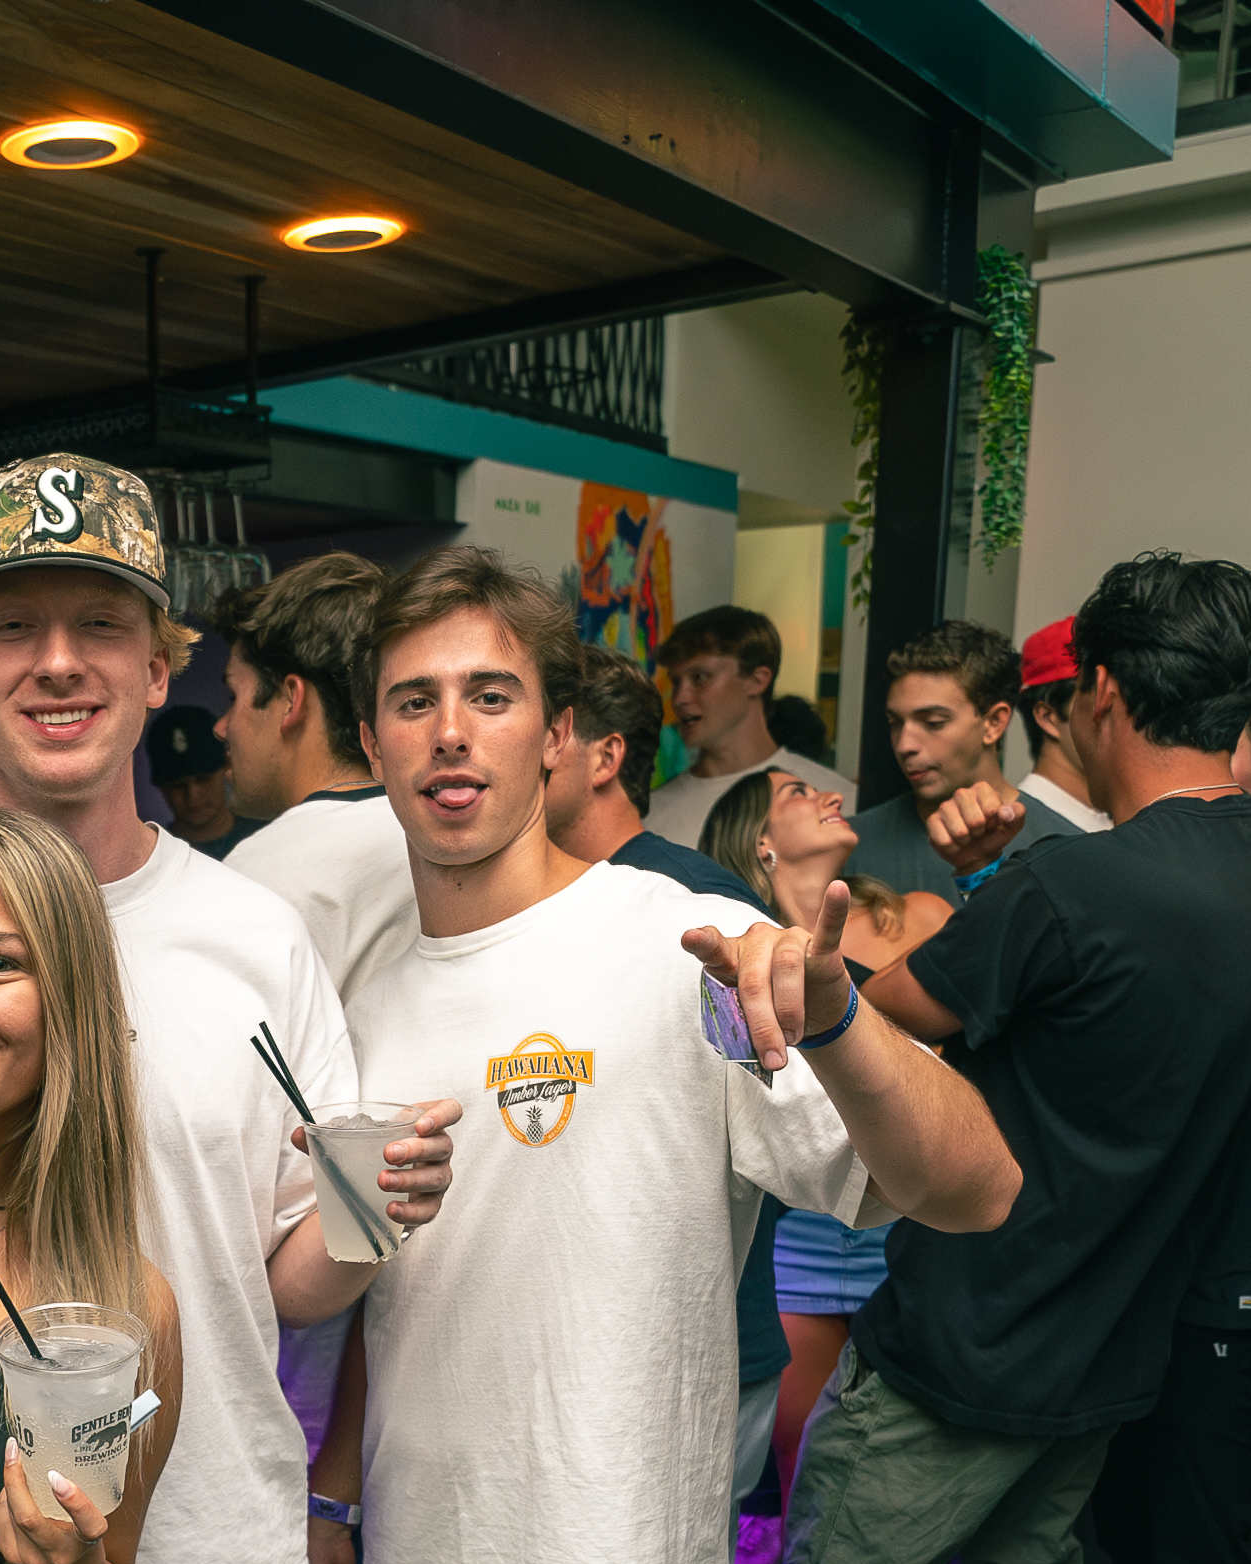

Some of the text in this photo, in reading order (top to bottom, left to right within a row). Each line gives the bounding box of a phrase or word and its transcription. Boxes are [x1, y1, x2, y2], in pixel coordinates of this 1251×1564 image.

[33, 466, 84, 543] S
[490, 1054, 589, 1084] HAWAIIANA
[500, 1080, 574, 1108] Amber Lager
[71, 1410, 116, 1444] GENTLE
[74, 1444, 122, 1463] BREWING
